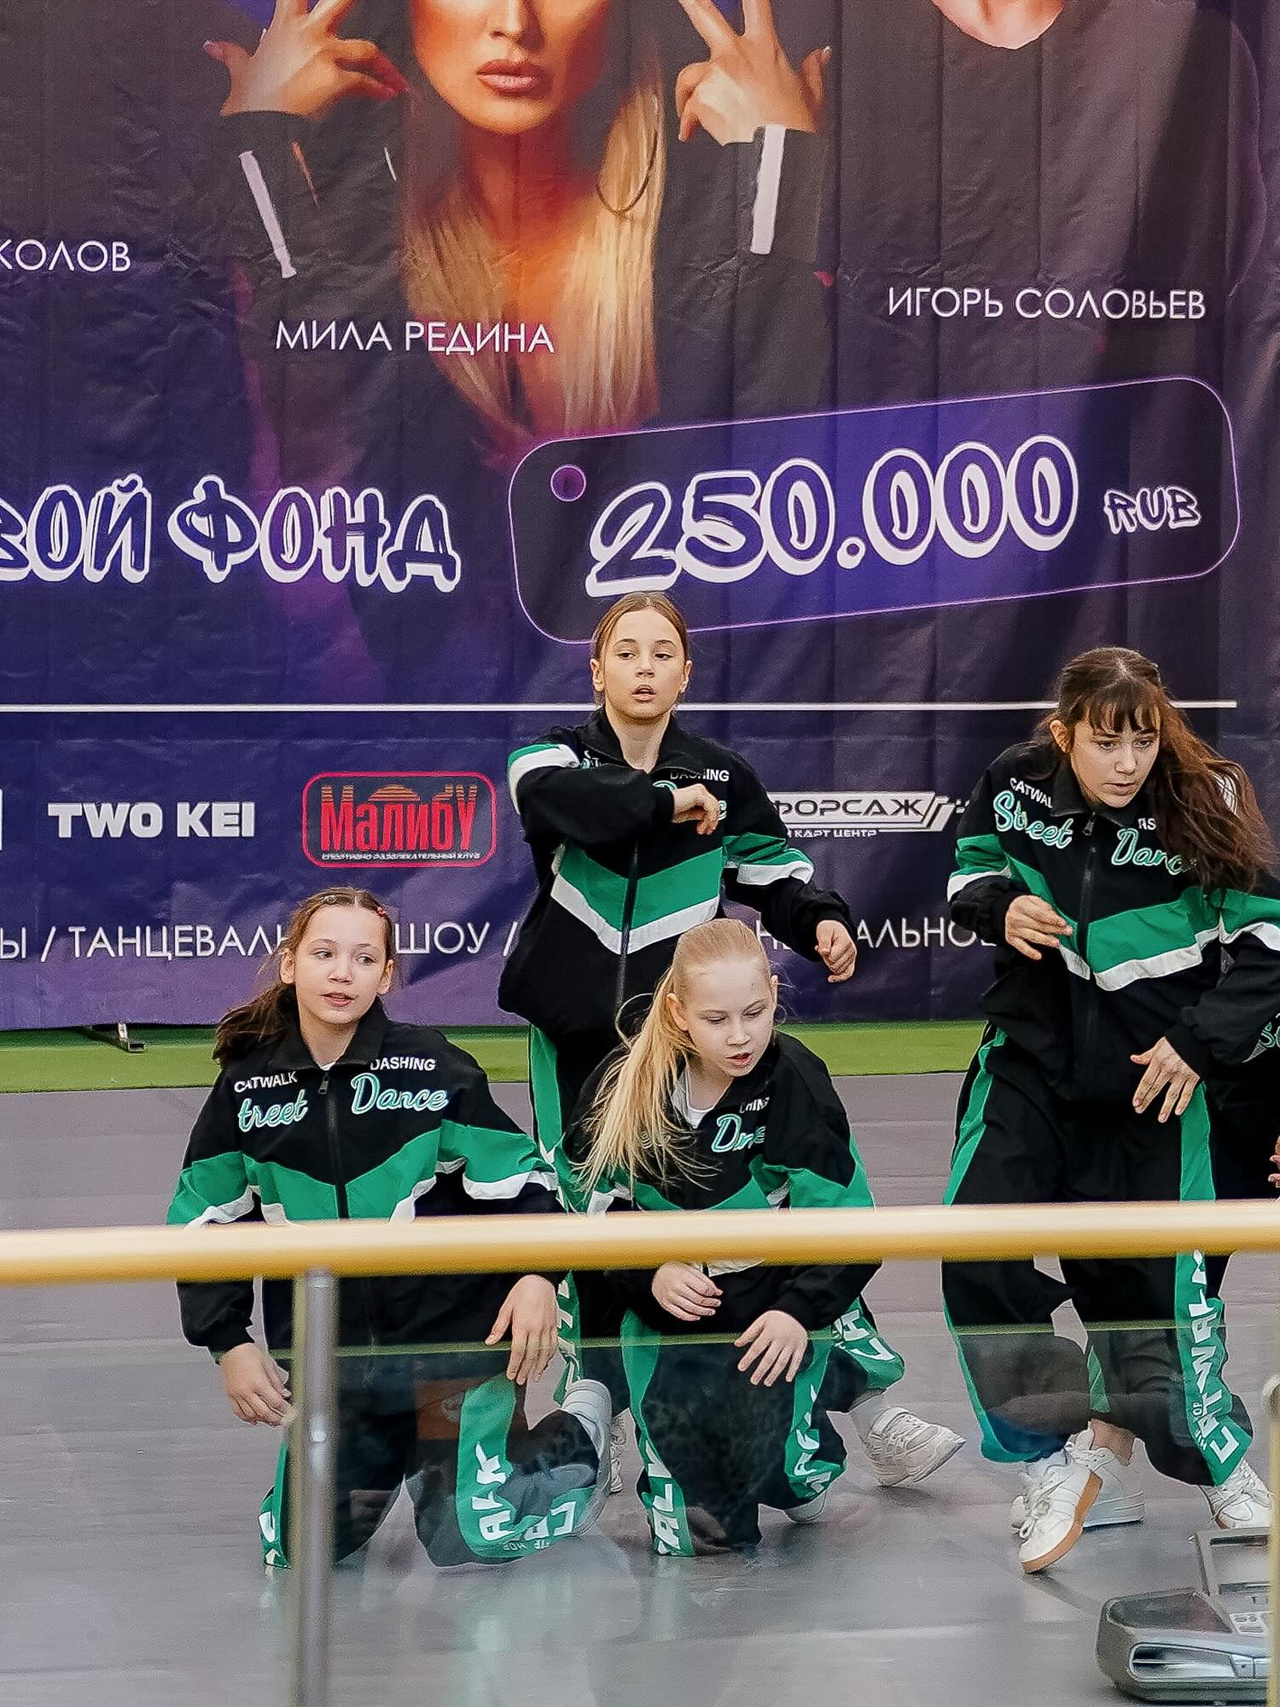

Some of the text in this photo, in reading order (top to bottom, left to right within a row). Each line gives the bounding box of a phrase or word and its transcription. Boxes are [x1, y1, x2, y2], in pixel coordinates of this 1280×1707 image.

[0, 239, 131, 272] КОЛОВ
[888, 287, 1207, 319] ИГОРЬ СОЛОВЬЕВ
[275, 321, 556, 356] МИЛА РЕДИНА
[168, 475, 461, 593] ФОНД
[585, 434, 1202, 598] 250.000 RUB
[1009, 777, 1053, 809] CATWAL
[48, 801, 256, 839] TWO KEI
[833, 829, 878, 839] ЦЕНТР
[1111, 828, 1190, 875] Danc
[68, 925, 290, 960] ТАНЦЕВАЛ
[395, 922, 490, 955] ШОУ
[370, 1056, 437, 1072] DASHING
[237, 1072, 450, 1133] treet Dance
